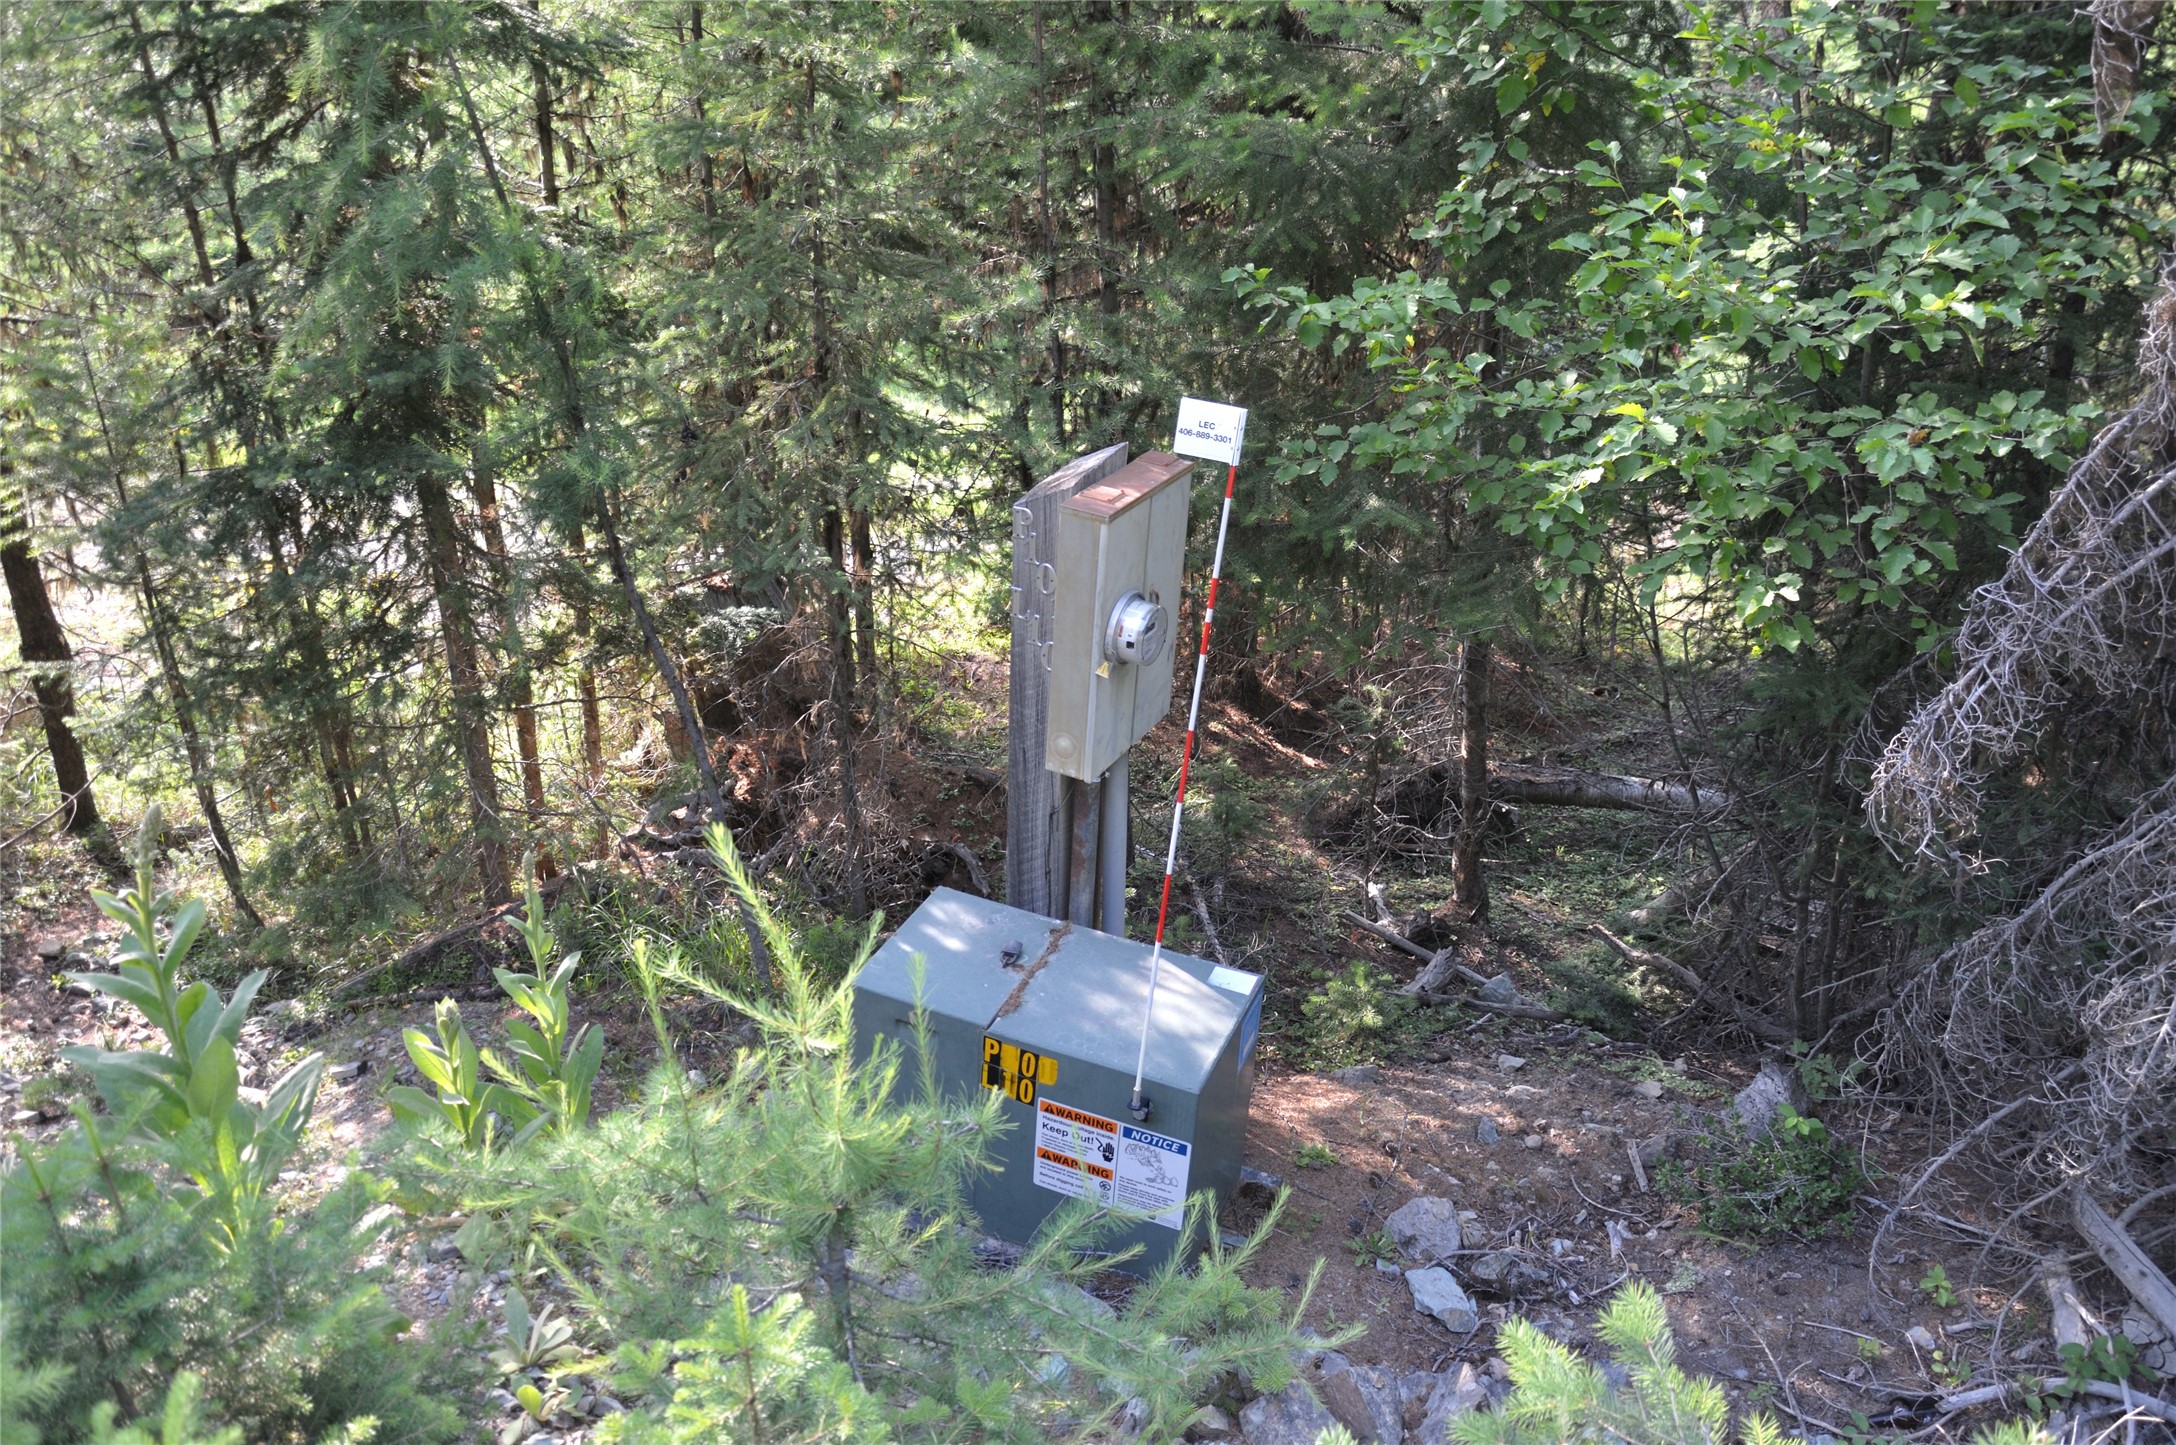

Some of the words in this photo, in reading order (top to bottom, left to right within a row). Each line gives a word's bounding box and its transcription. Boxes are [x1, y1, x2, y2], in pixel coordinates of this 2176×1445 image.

[1178, 427, 1232, 444] 406-889-3301
[1198, 421, 1215, 430] LEC
[1056, 1107, 1113, 1132] WARNING
[1042, 1122, 1068, 1138] Keep
[1130, 1130, 1180, 1153] NOTICE
[1052, 1154, 1108, 1179] WARING
